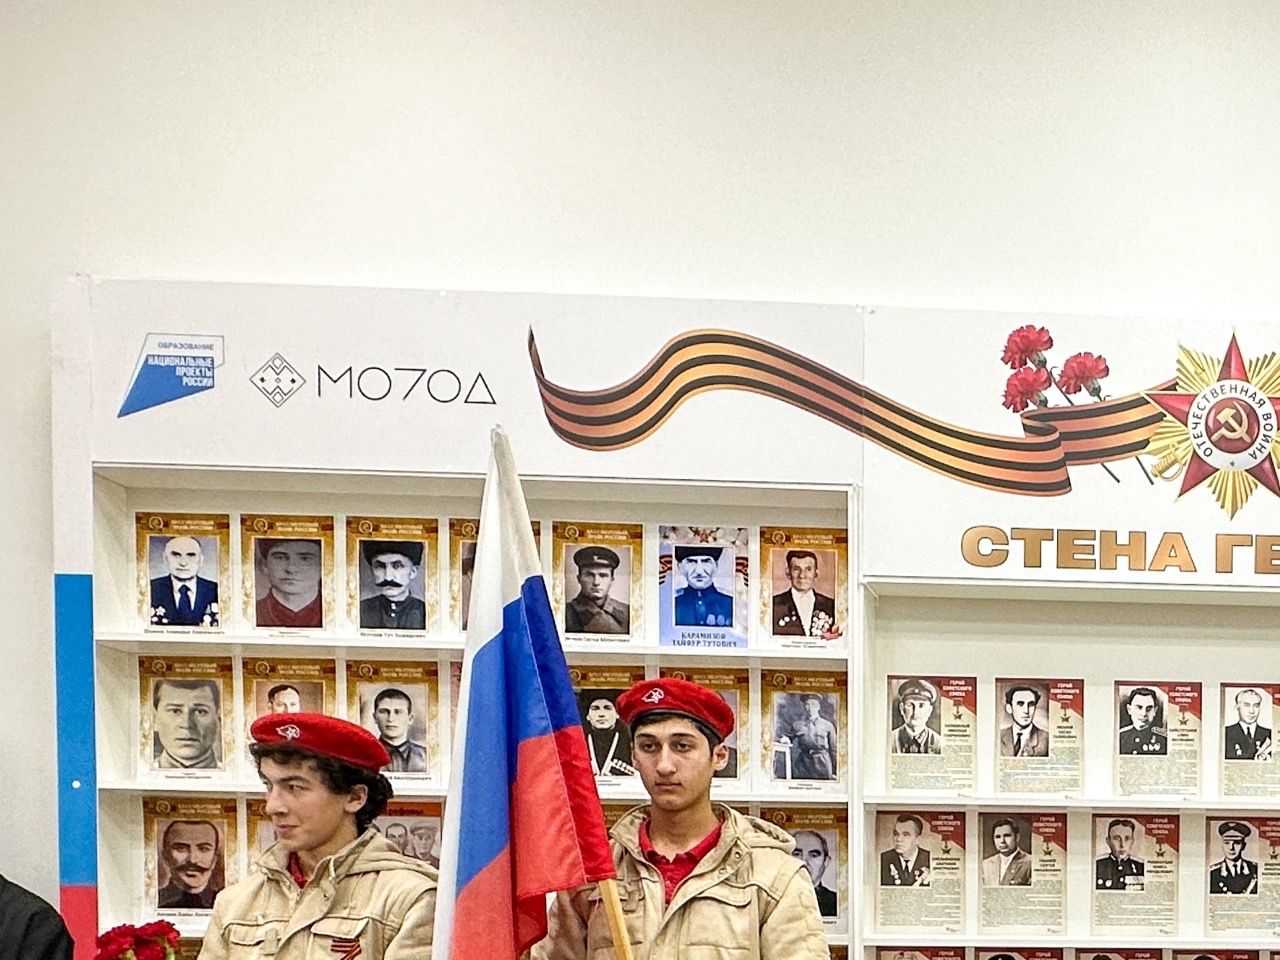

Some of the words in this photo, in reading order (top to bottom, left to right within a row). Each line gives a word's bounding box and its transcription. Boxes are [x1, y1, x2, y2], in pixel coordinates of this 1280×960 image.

[158, 342, 214, 350] ОБРАЗОВАНИЕ
[147, 356, 213, 367] НАЦИОНАЛЬНЫЕ
[175, 366, 213, 377] ПРОЕКТЫ
[182, 377, 213, 386] РОССИИ
[1191, 384, 1266, 457] ОТЕЧЕСТВЕННАЯ
[1248, 412, 1274, 460] ВОЙНА
[960, 525, 1197, 573] СТЕНА
